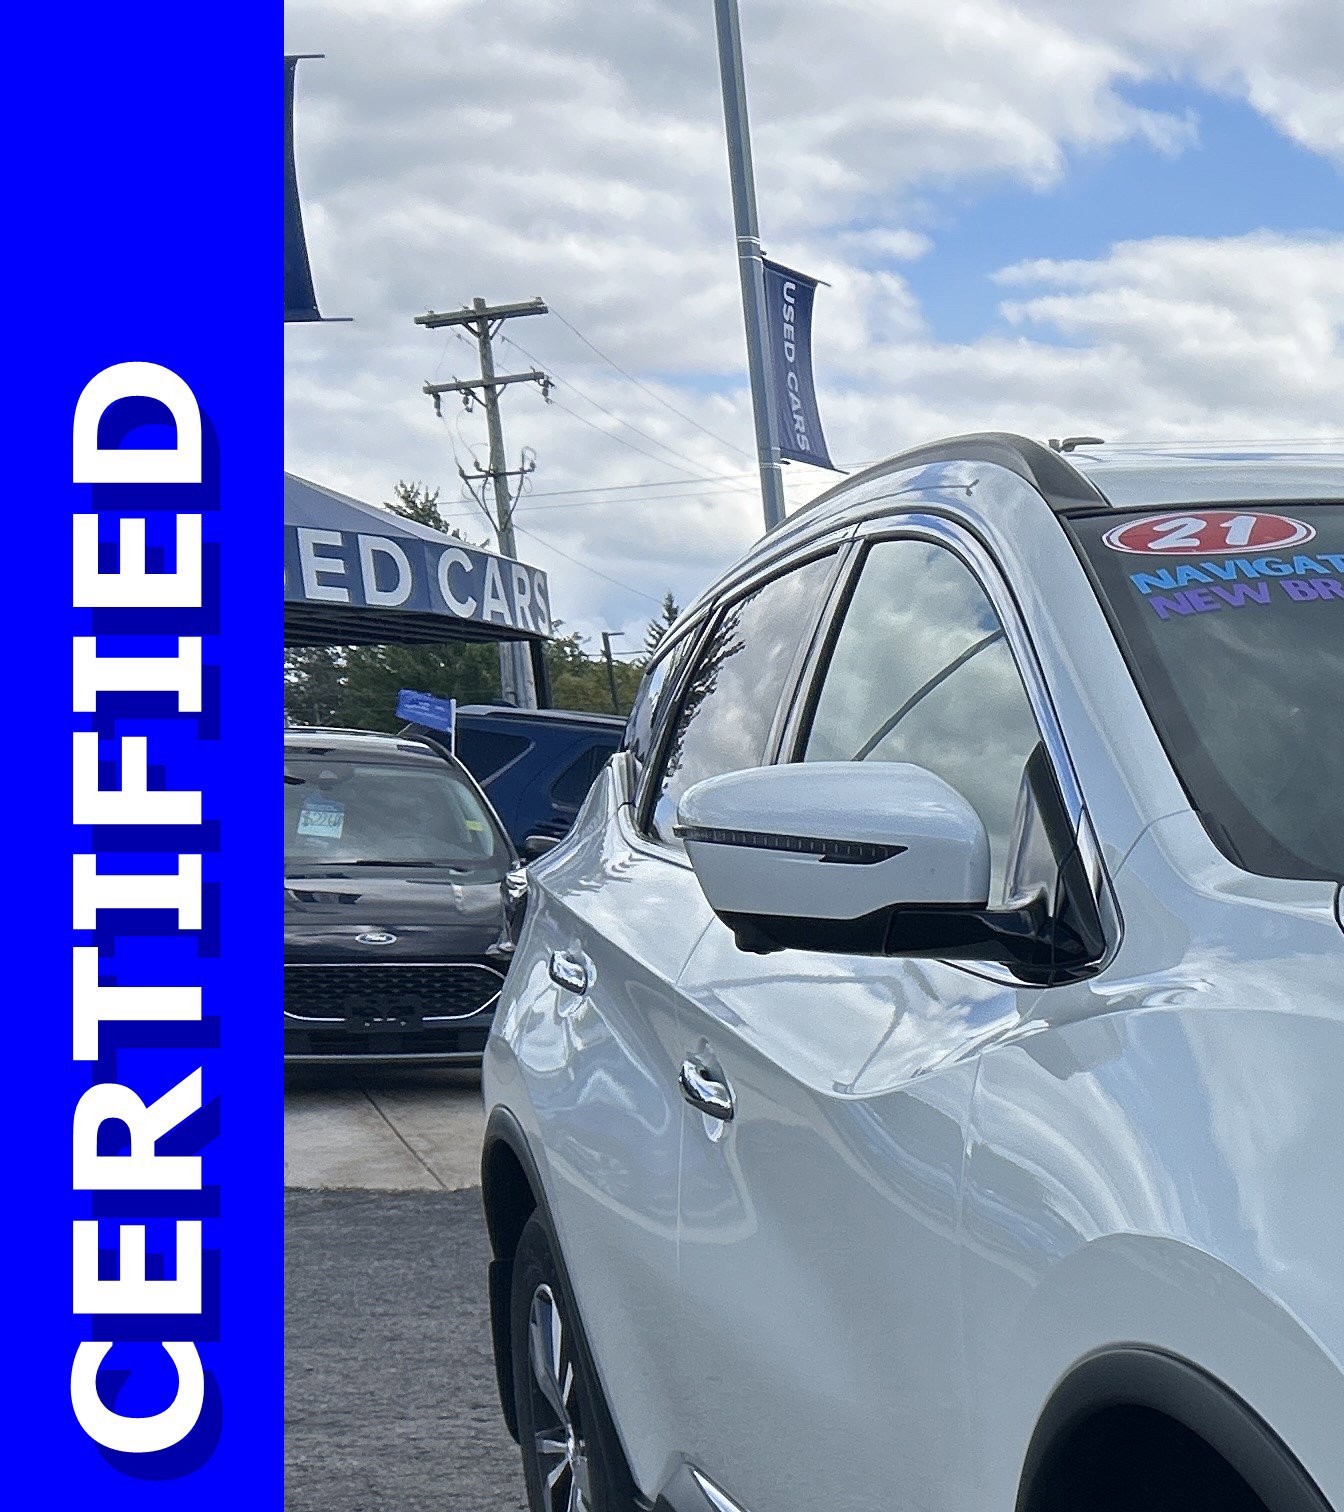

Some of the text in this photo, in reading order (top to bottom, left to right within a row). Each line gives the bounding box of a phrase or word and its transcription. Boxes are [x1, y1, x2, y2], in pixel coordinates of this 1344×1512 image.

[782, 281, 811, 451] USED CARS
[1148, 515, 1257, 550] 21
[284, 527, 550, 636] ED CARS
[1149, 580, 1271, 620] NEW
